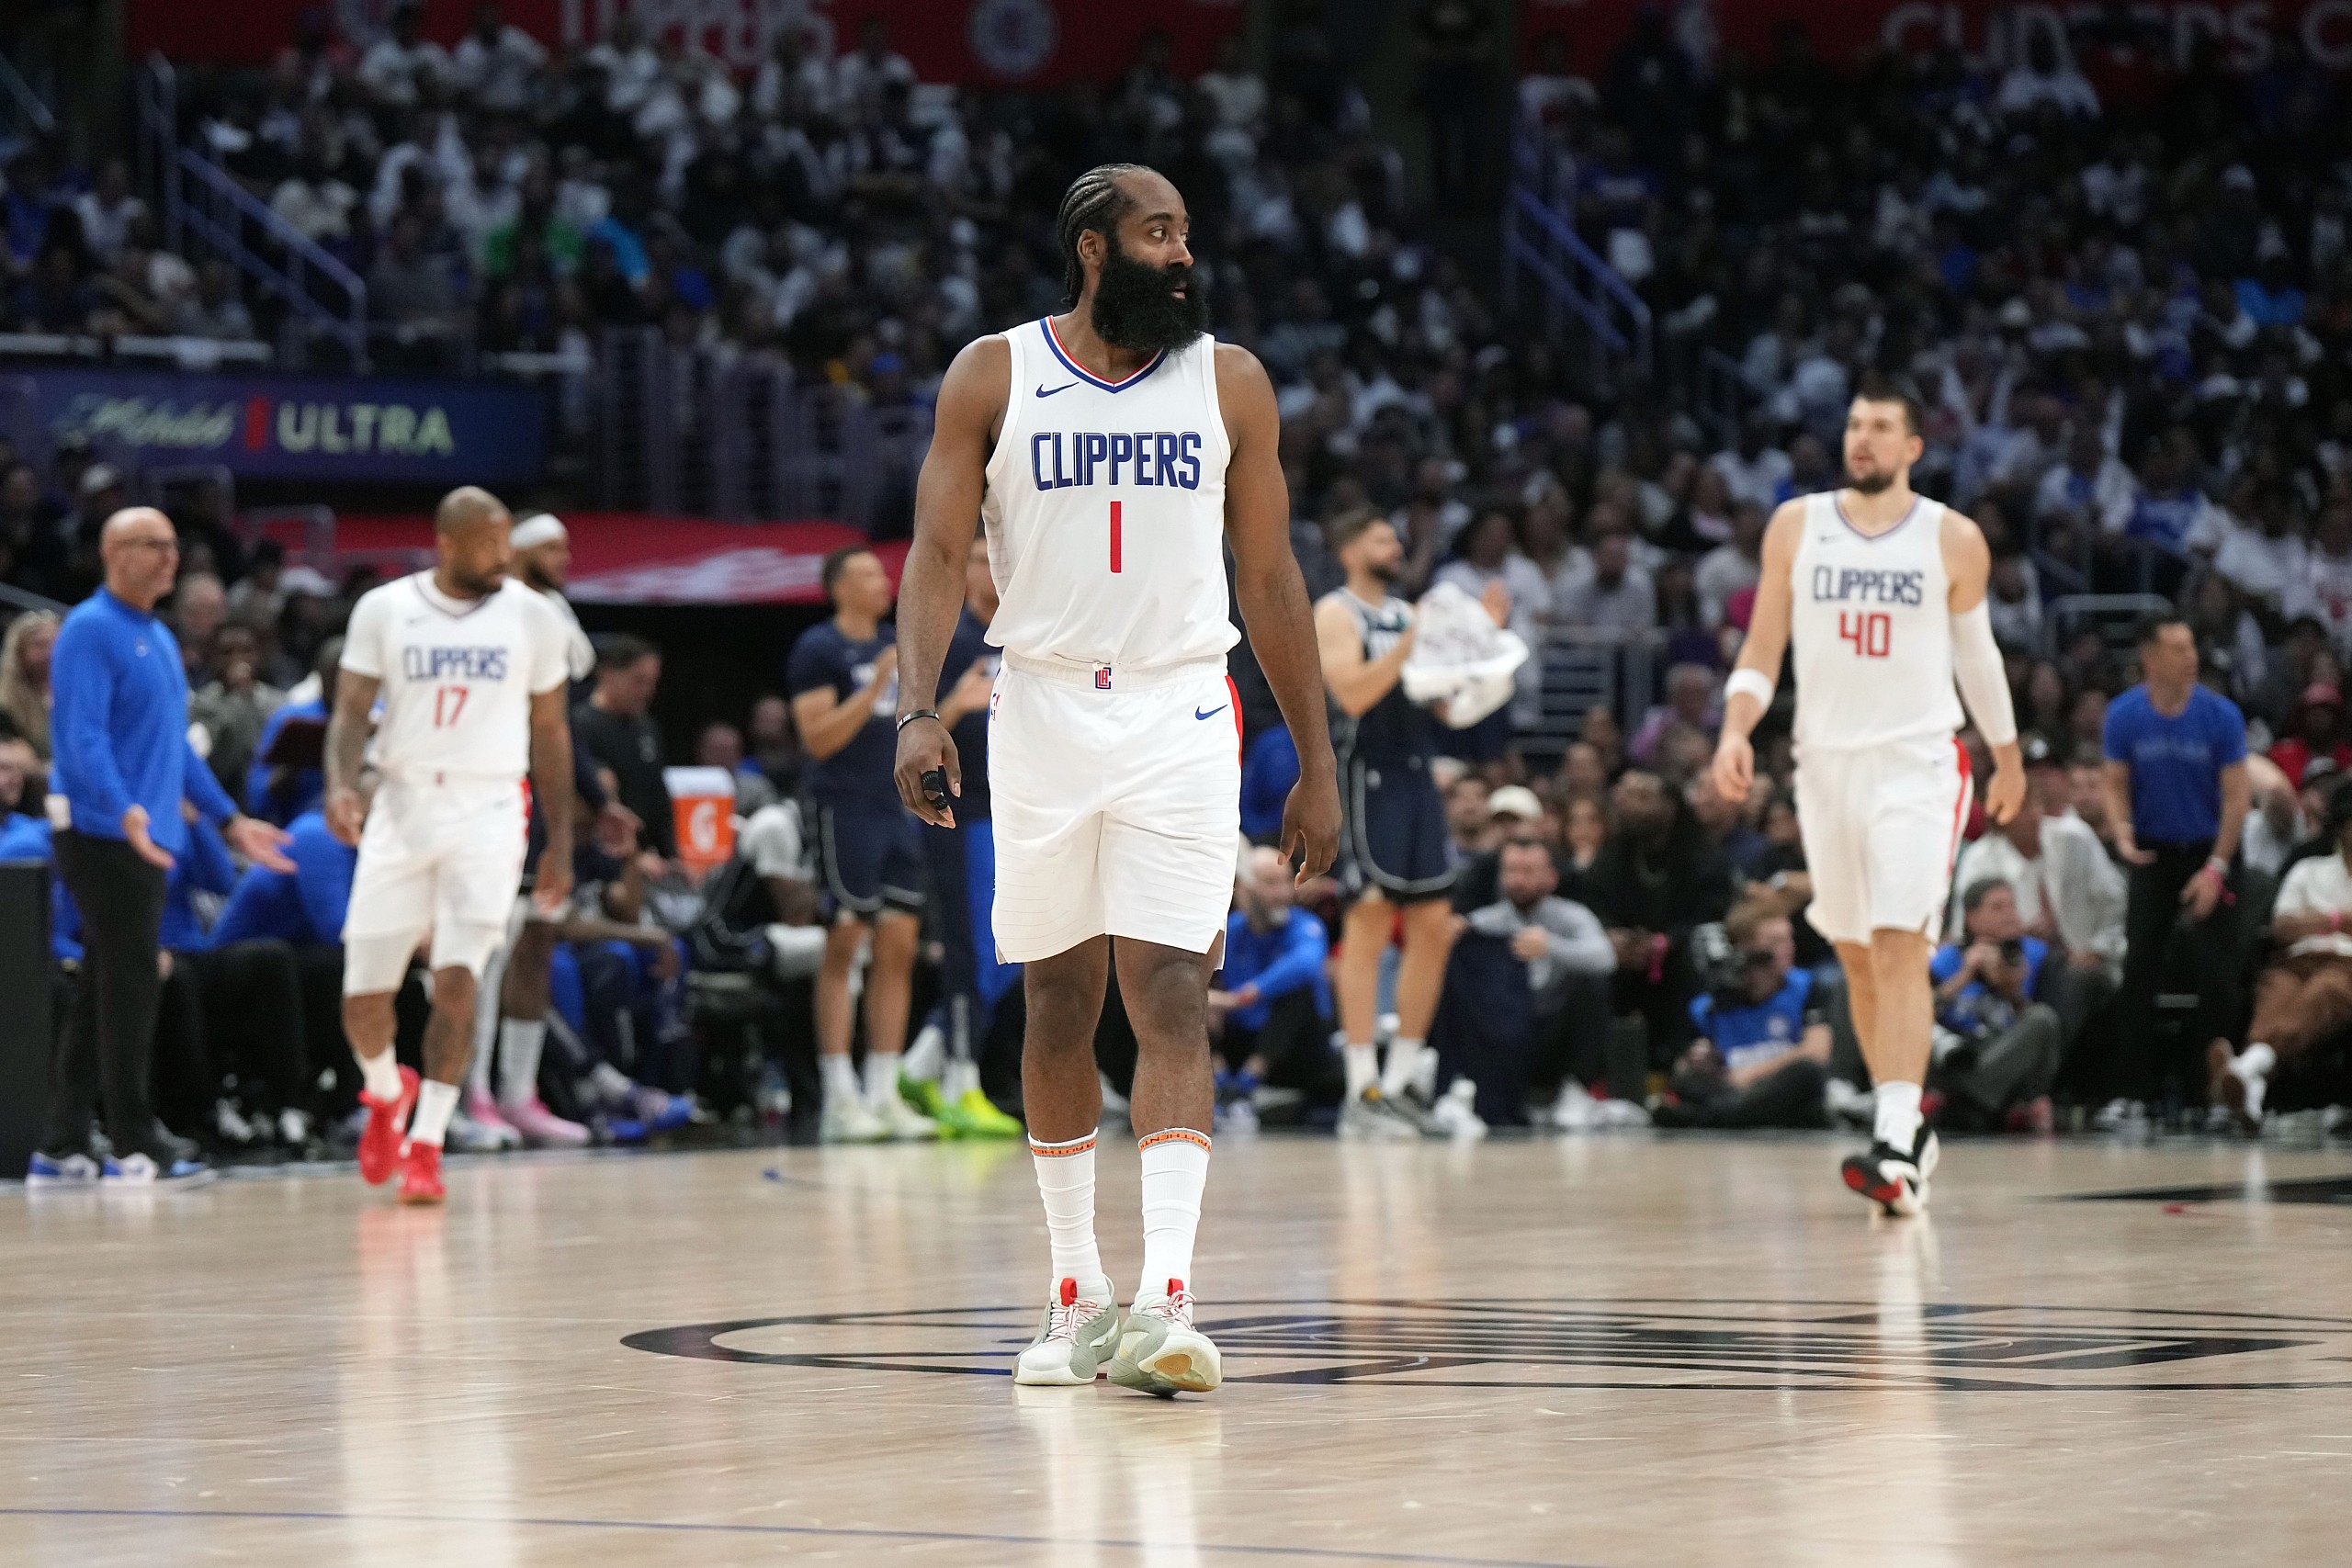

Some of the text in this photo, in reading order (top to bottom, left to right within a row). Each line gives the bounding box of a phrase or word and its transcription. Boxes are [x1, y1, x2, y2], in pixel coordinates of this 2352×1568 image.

[278, 401, 454, 456] ULTRA
[1031, 432, 1202, 491] CLIPPERS
[1110, 501, 1122, 573] 1
[1814, 565, 1924, 606] CLIPPERS
[1839, 611, 1891, 658] 40
[402, 645, 507, 681] CLIPPERS
[434, 685, 469, 728] 17
